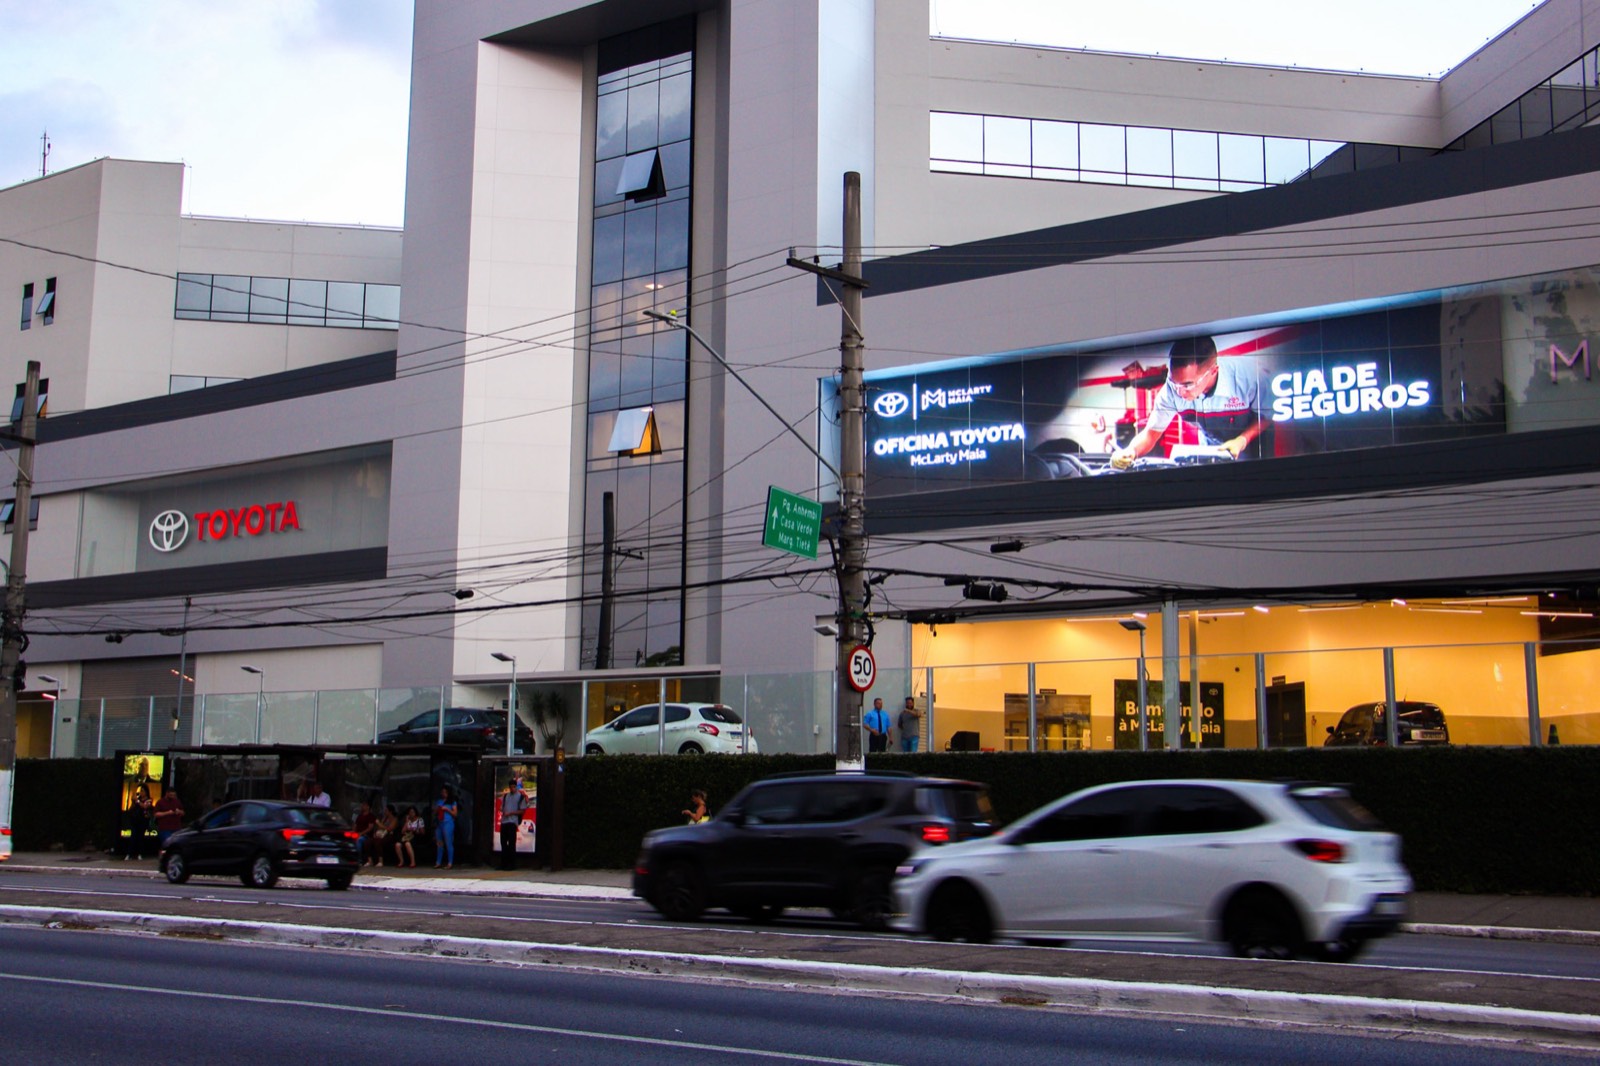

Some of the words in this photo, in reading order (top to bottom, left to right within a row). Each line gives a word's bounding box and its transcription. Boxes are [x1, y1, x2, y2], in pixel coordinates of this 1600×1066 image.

[1271, 369, 1328, 397] CIA
[1332, 362, 1378, 390] DE
[948, 385, 992, 397] MCLARTY
[948, 395, 973, 404] MAIA
[1272, 381, 1430, 421] SEGUROS
[874, 432, 949, 456] OFICINA
[950, 423, 1025, 447] TOYOTA
[910, 450, 958, 466] McLarty
[959, 447, 987, 461] Maia
[194, 500, 300, 541] TOYOTA
[793, 503, 818, 520] Anhembi
[780, 515, 795, 530] Casa
[796, 520, 813, 536] Verde
[853, 655, 872, 676] 50
